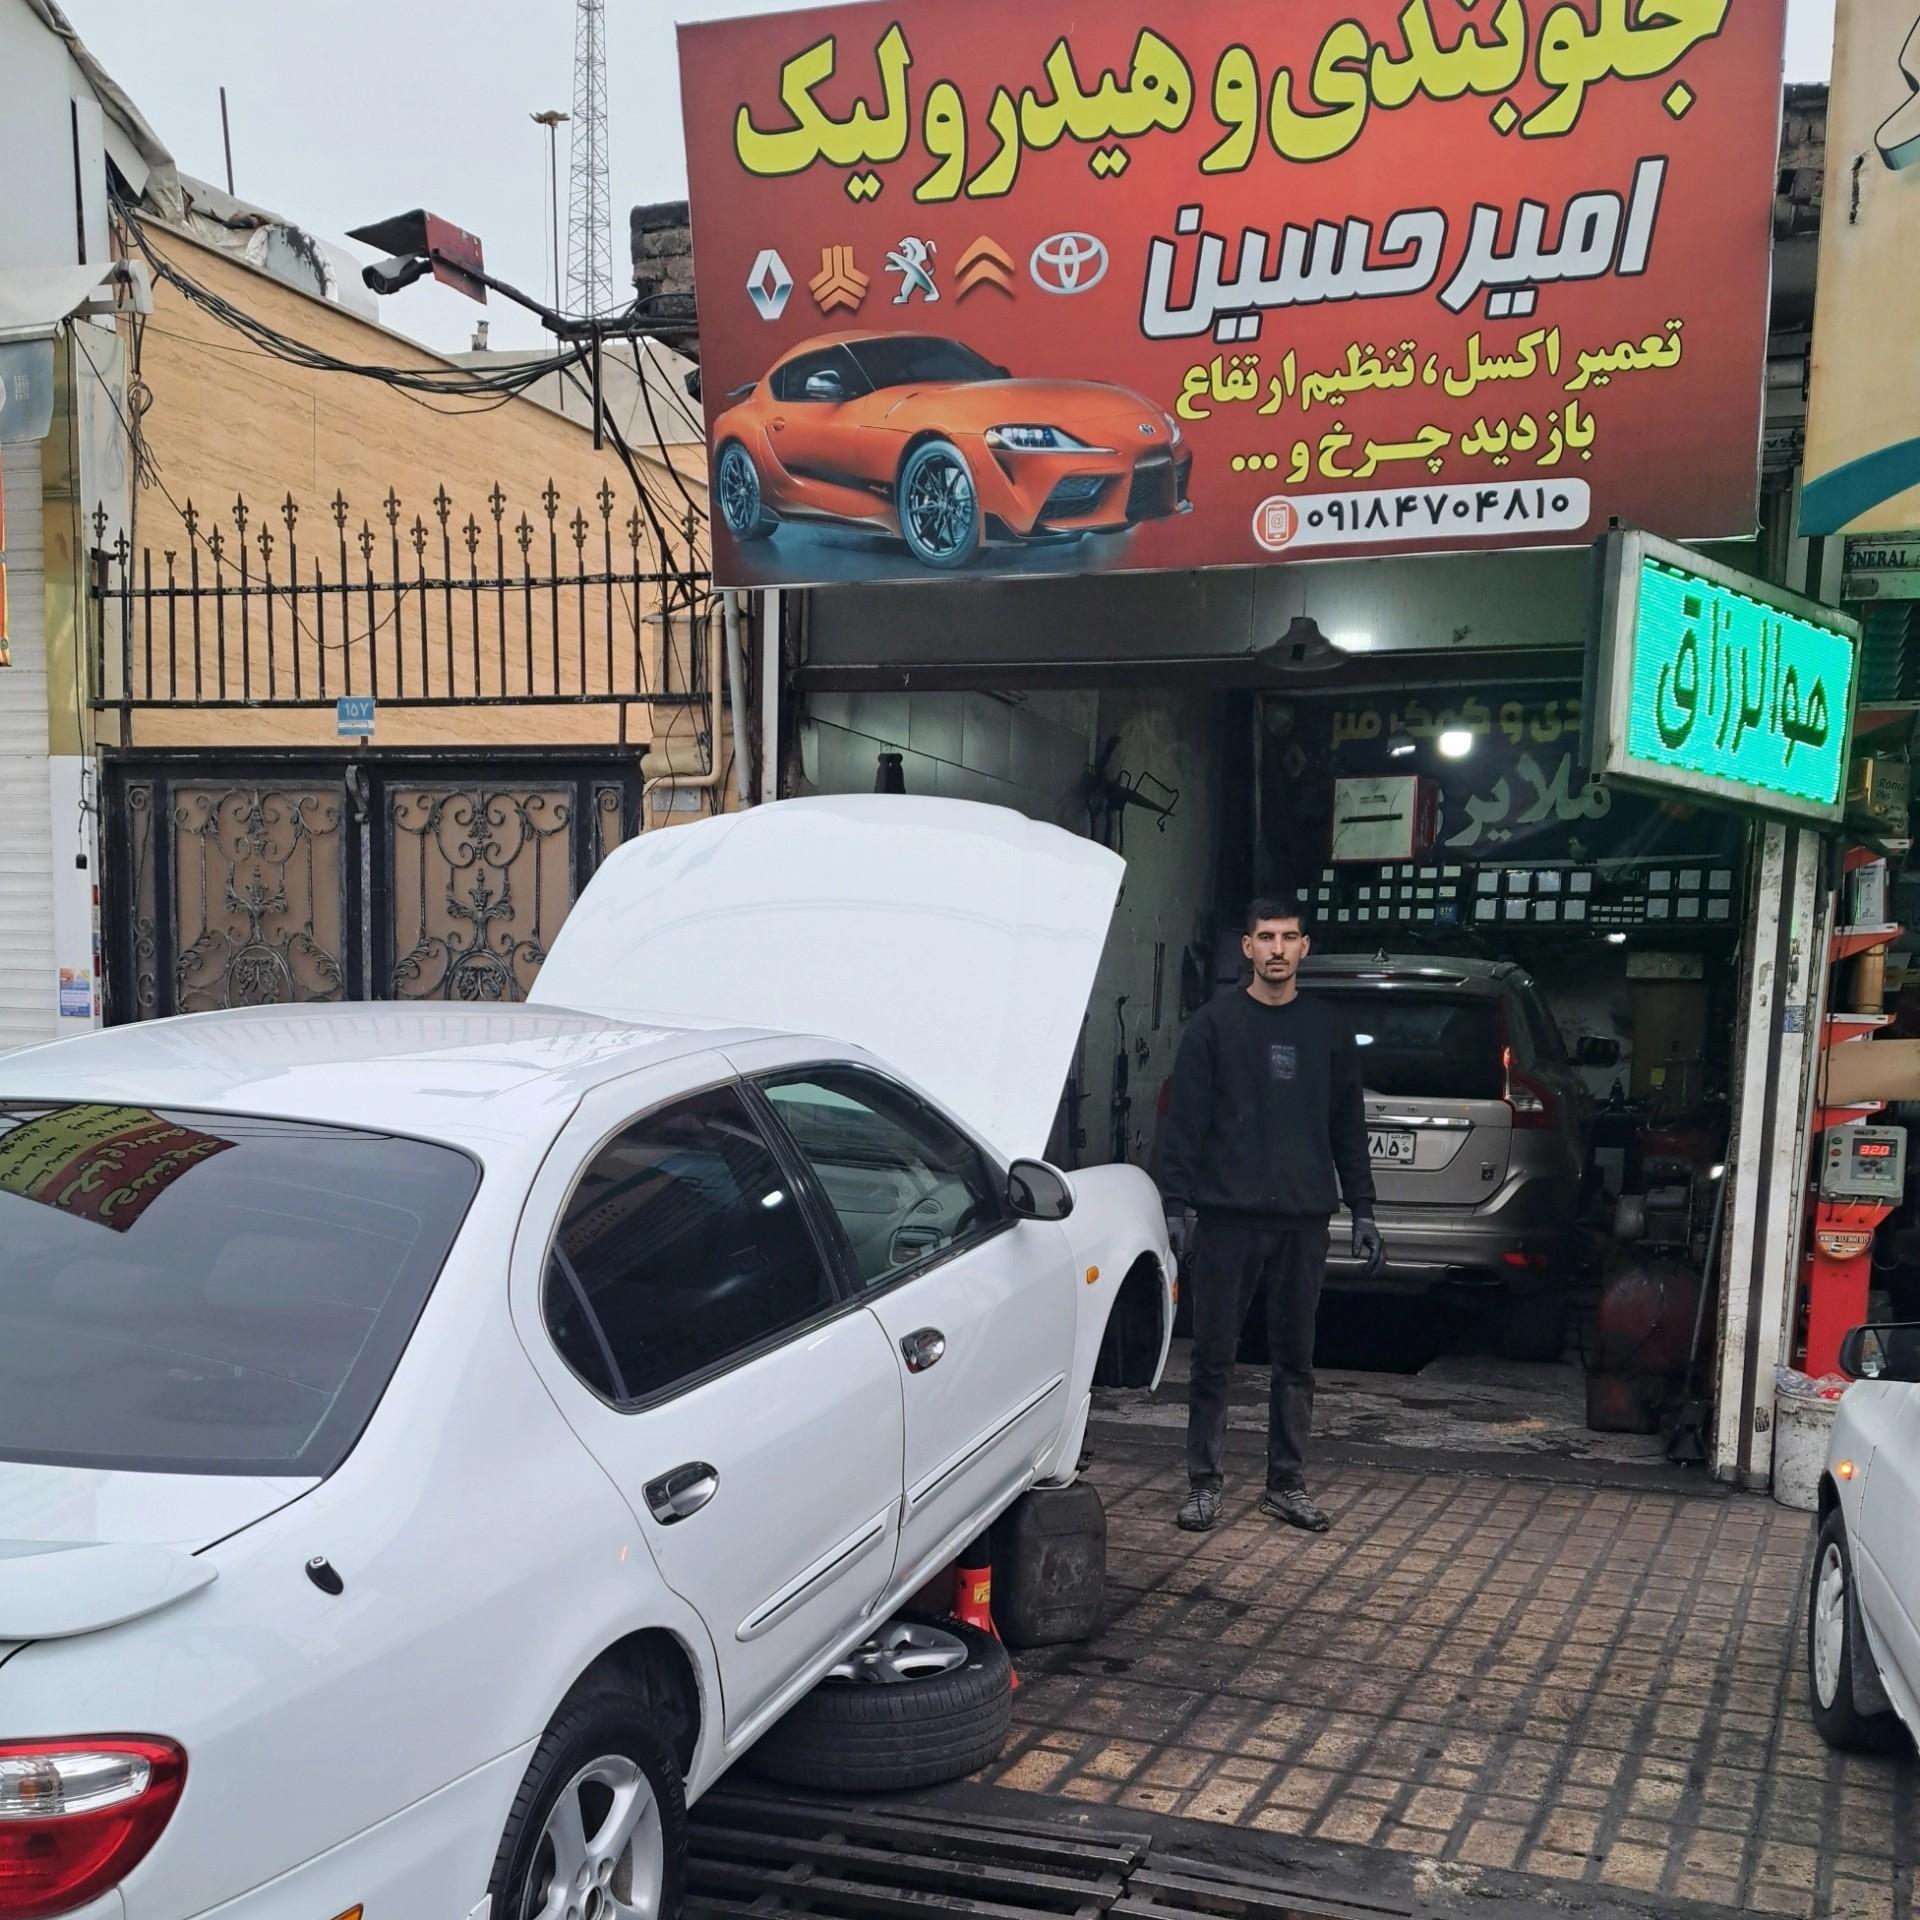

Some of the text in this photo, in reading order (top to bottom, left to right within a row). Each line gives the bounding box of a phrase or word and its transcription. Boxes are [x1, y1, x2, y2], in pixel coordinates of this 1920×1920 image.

[734, 22, 1194, 202] هیدرولیک
[1201, 46, 1261, 174] و
[1175, 349, 1297, 421] ارتفاع
[1301, 340, 1417, 411] تنظیم
[1564, 318, 1683, 391] تعمیر
[1286, 437, 1311, 485] و
[1460, 399, 1597, 468] بازدید
[1844, 550, 1909, 569] ENERAL
[345, 702, 369, 717] ۱۵۷
